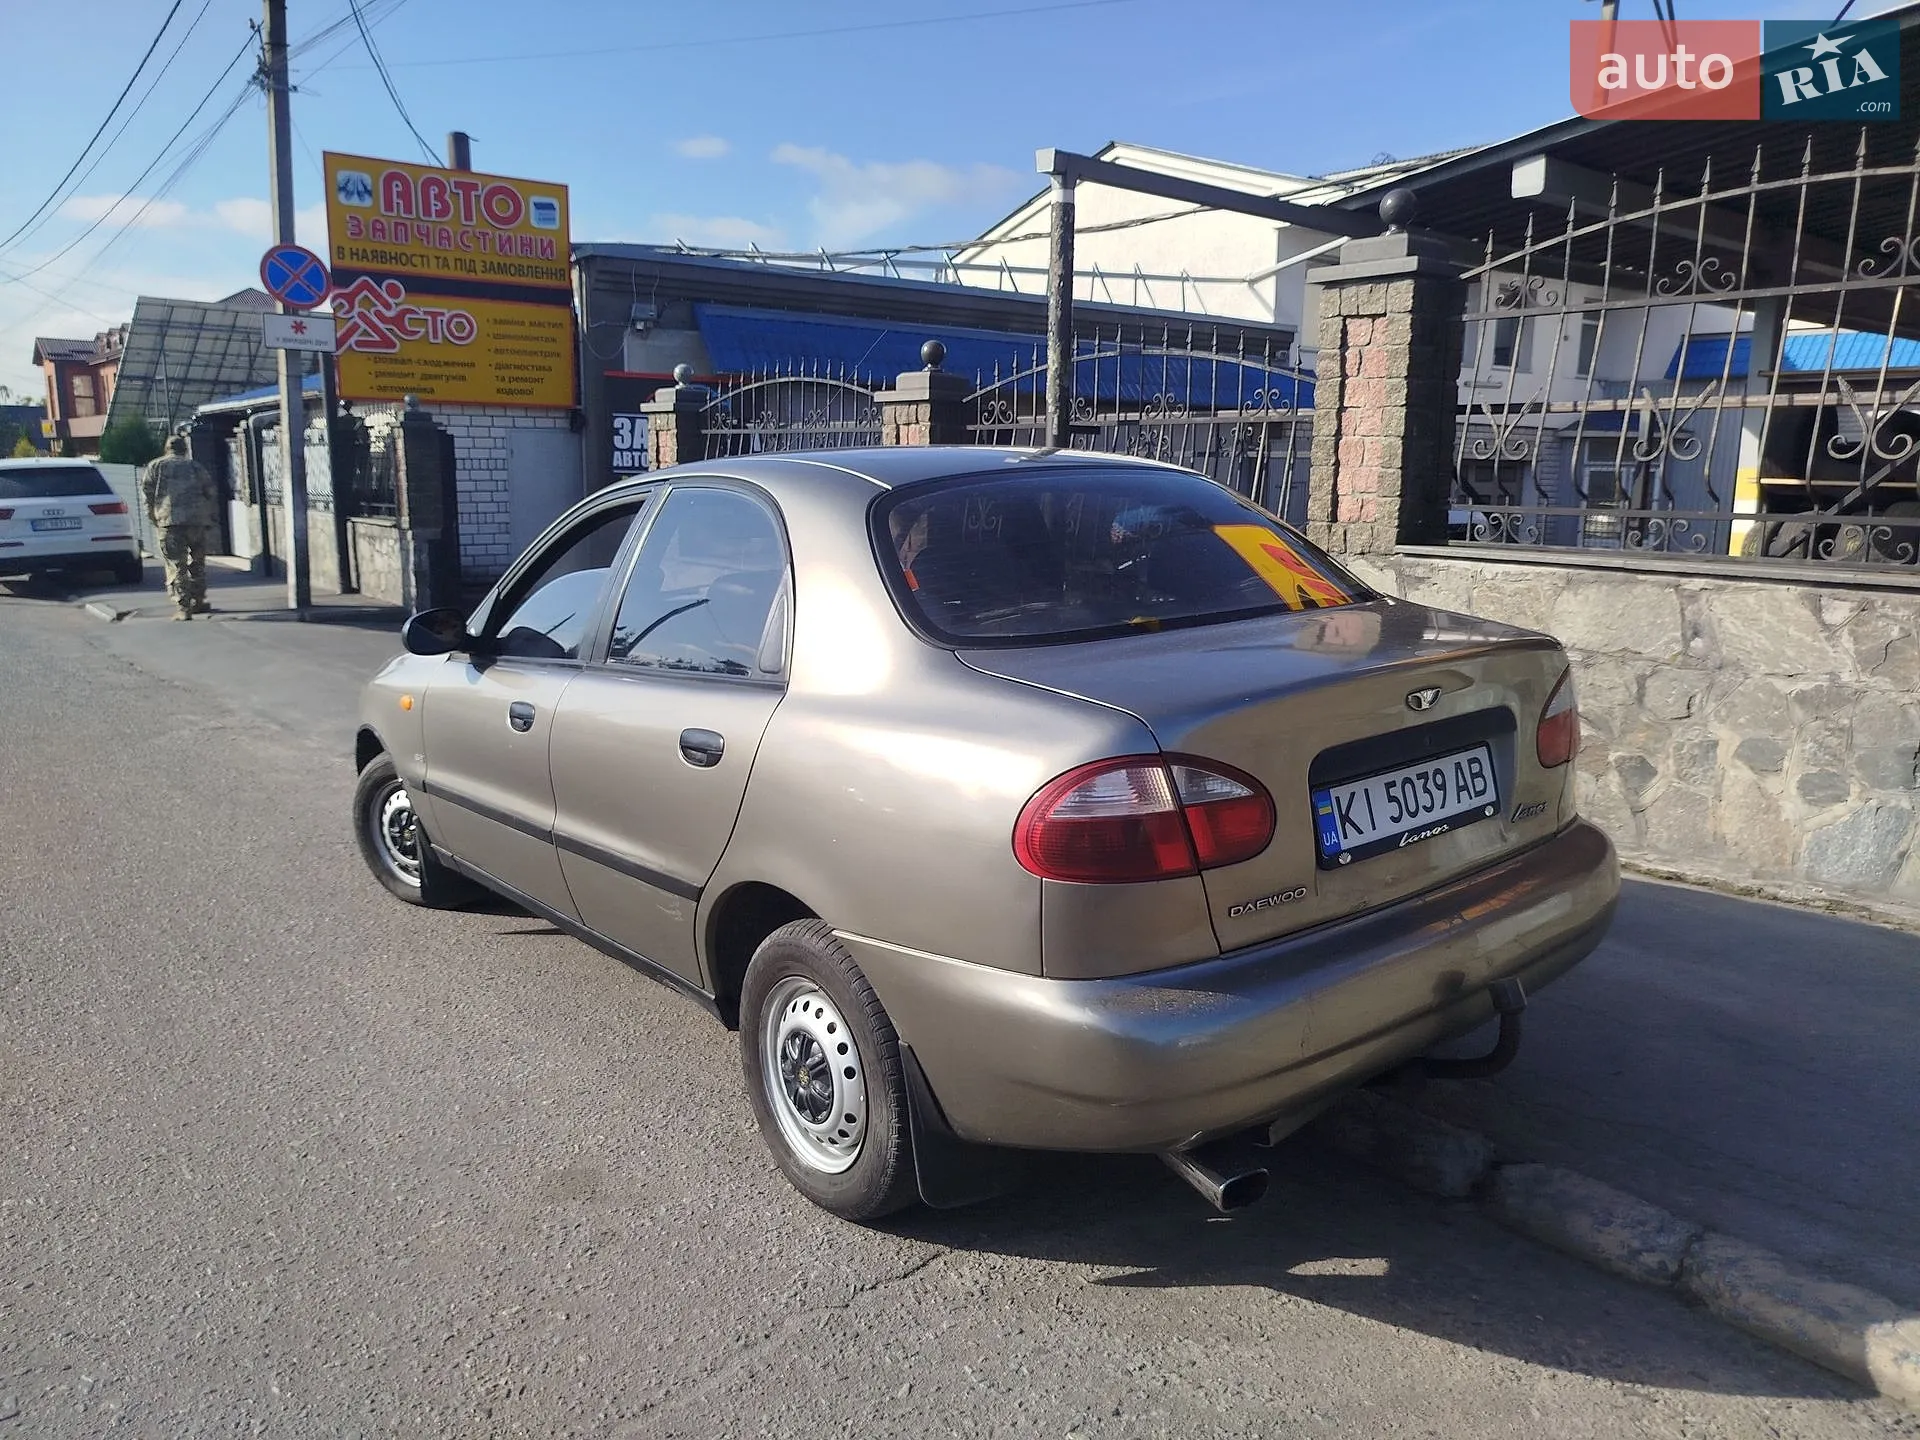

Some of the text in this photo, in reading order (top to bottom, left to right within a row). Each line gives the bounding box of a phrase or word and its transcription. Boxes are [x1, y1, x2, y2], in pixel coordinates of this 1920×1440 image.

[380, 169, 525, 229] АВТО
[347, 214, 558, 260] ЗАПЧАСТИНИ
[336, 246, 567, 282] В НАЯВНОСТІ ТА ПІД ЗАМОВЛЕННЯ
[399, 304, 478, 345] СТО
[1335, 756, 1488, 840] KI 5039 AB
[1323, 831, 1339, 847] UA
[1398, 822, 1450, 848] Lanos
[1228, 886, 1308, 919] DAEWOO
